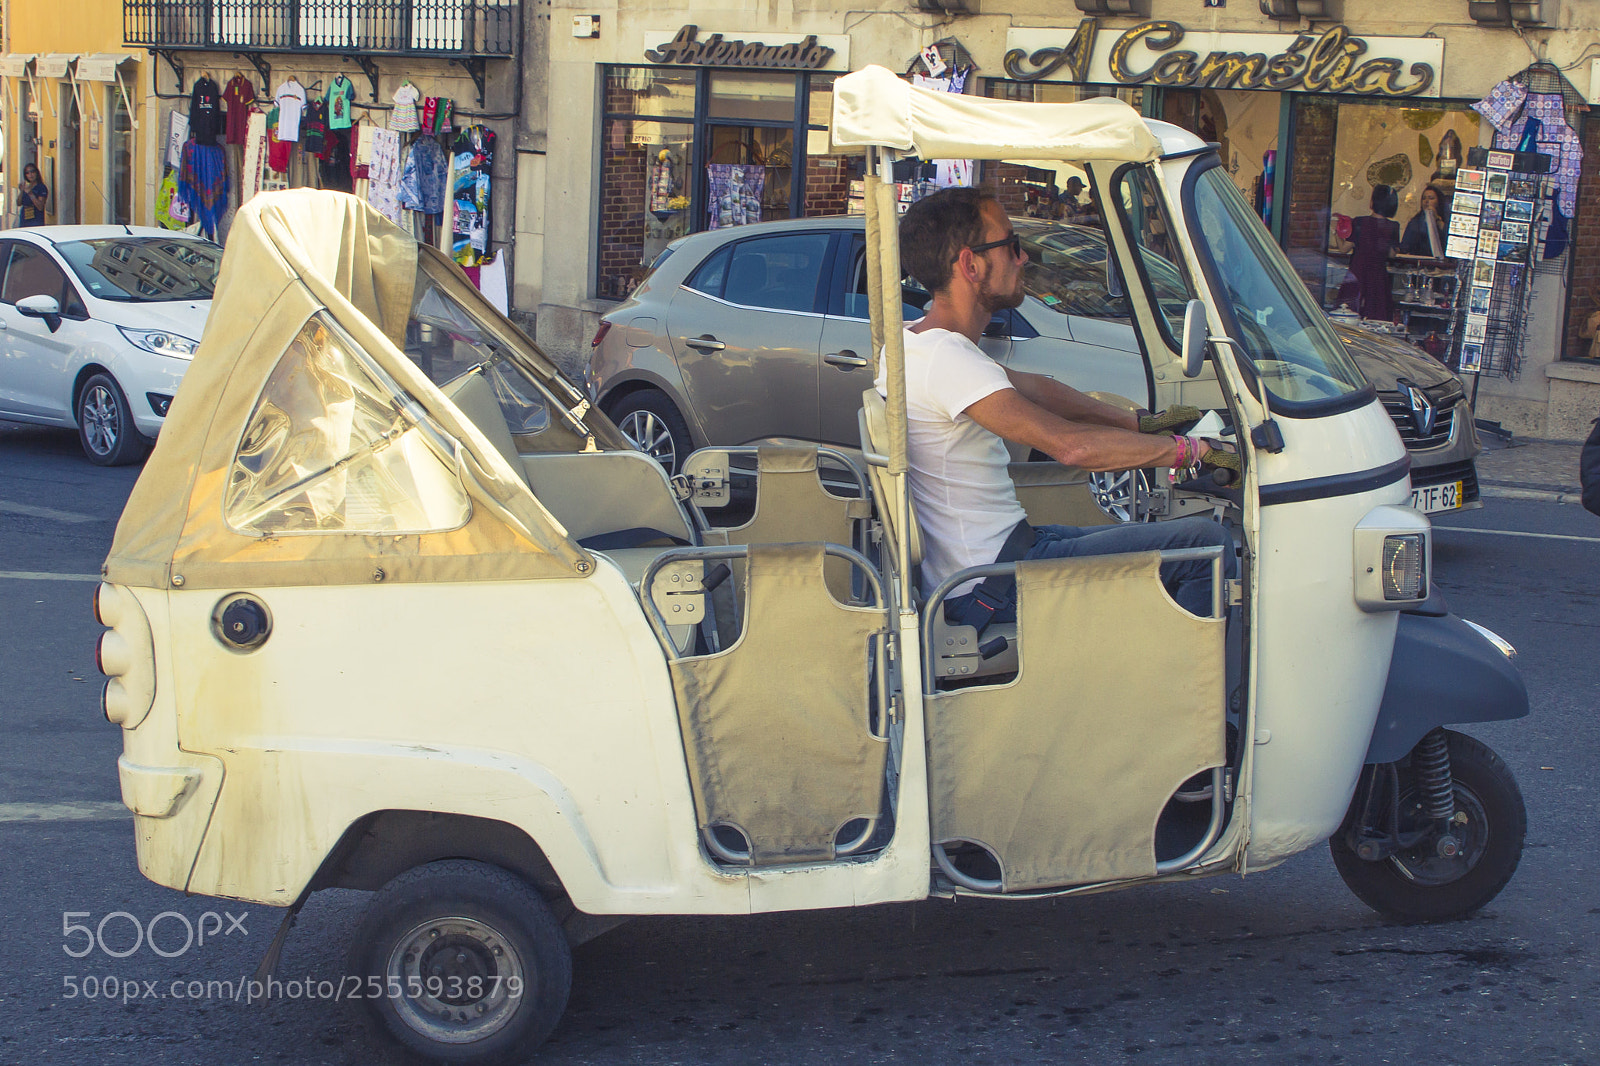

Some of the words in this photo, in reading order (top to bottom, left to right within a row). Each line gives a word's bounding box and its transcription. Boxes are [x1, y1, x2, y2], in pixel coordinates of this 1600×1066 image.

[644, 24, 836, 69] Artesanato
[1003, 17, 1097, 82] A
[1109, 20, 1434, 96] Camélia
